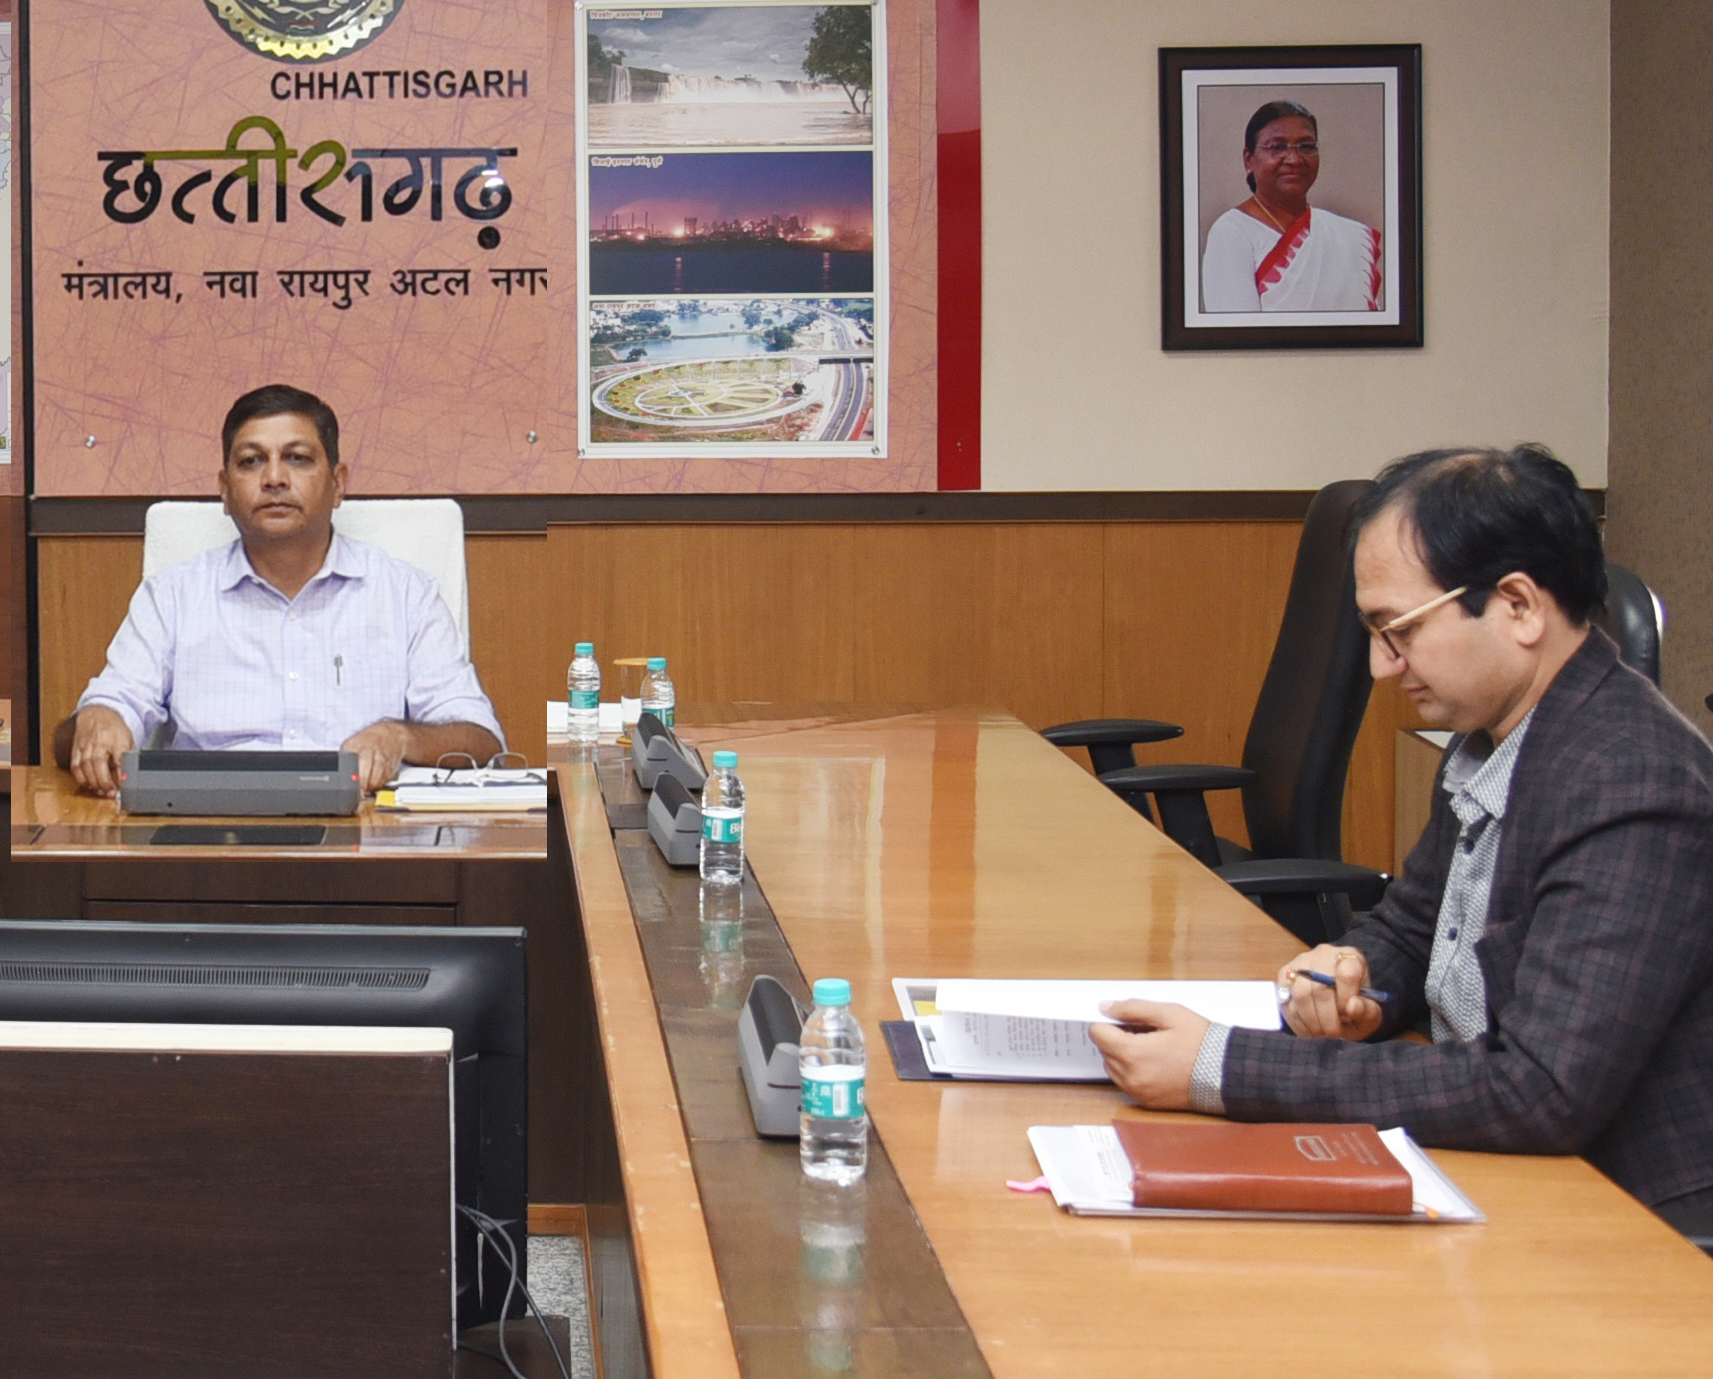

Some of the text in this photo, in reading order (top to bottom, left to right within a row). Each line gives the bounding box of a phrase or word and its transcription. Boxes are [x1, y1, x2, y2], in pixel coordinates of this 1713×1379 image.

[270, 69, 528, 100] CHHATTISGARH
[61, 260, 183, 304] मंत्रालय,
[203, 270, 258, 299] नवा
[277, 269, 370, 310] रायपुर
[389, 268, 471, 297] अटल
